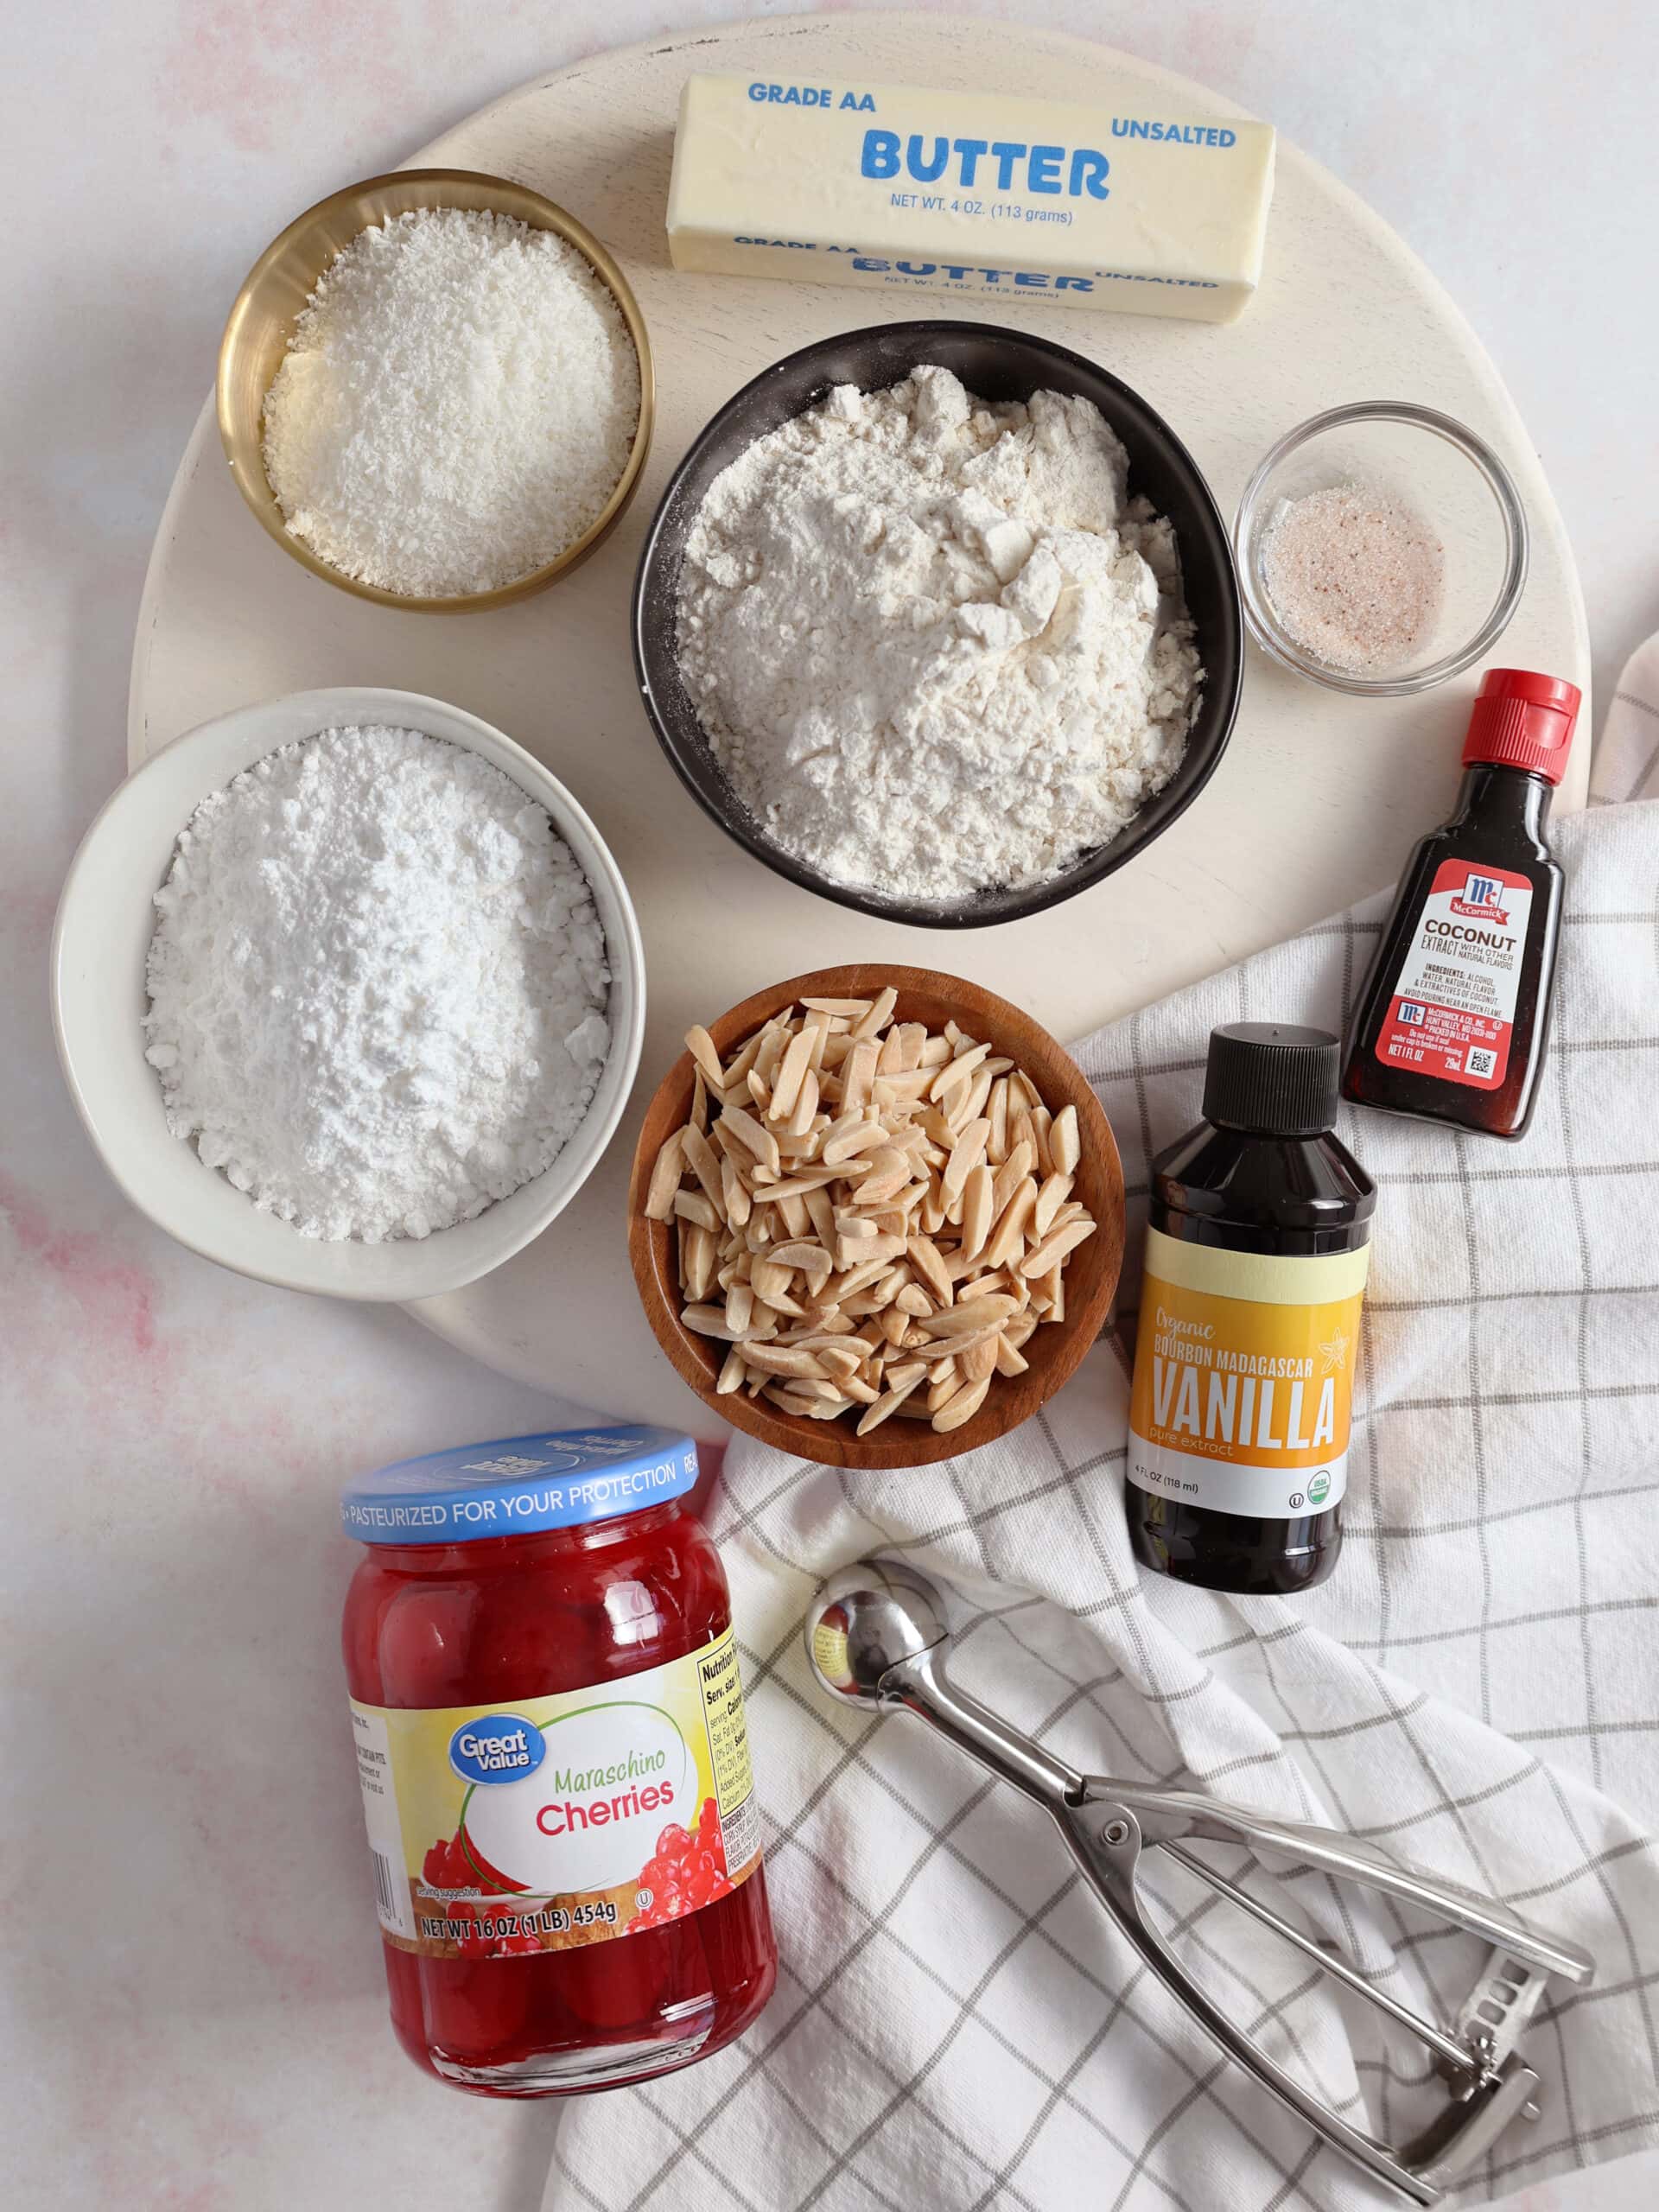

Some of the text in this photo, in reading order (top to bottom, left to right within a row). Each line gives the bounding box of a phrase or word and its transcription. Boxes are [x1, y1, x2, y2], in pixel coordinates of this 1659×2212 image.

[748, 82, 876, 112] GRADE AA
[1111, 118, 1236, 148] UNSALTED
[860, 129, 1110, 200] BUTTER
[891, 194, 1072, 226] NET WT. 4 OZ. (113 grams)
[734, 236, 861, 254] GRADE AA
[852, 257, 1095, 292] BUTTER
[1095, 270, 1219, 289] UNSALTED
[1452, 903, 1503, 918] McCormick
[1421, 935, 1514, 962] EXTRACT WITH OTHER
[1425, 919, 1516, 951] COCONUT
[1426, 963, 1466, 978] INGREDIENTS:
[1459, 951, 1514, 970] NATURAL FLAVORS
[1404, 988, 1421, 998] AVOID
[1420, 980, 1460, 995] EXTRACTIVES
[1446, 977, 1472, 990] NATURAL
[1389, 1043, 1402, 1057] NET
[1406, 1046, 1414, 1059] FL
[1414, 1049, 1424, 1062] OZ
[1156, 1306, 1216, 1339] Organic
[1154, 1333, 1313, 1378] BOURBON MADAGASCAR
[1154, 1356, 1334, 1450] VANILLA
[1149, 1427, 1234, 1457] pure extract
[350, 1504, 447, 1526] PASTEURIZED
[452, 1500, 498, 1523] FOR
[500, 1490, 563, 1519] YOUR
[569, 1461, 677, 1507] PROTECTION
[1150, 1471, 1162, 1484] OZ
[1164, 1476, 1181, 1489] (118
[1183, 1482, 1198, 1494] ml)
[702, 1651, 733, 1682] Nutrition
[706, 1687, 725, 1705] Serv.
[459, 1728, 528, 1758] Great
[477, 1751, 530, 1770] Value
[555, 1750, 665, 1794] Maraschino
[537, 1780, 674, 1835] Cherries
[441, 1886, 480, 1900] suggestion
[422, 1918, 445, 1937] NET
[447, 1919, 470, 1937] WT
[474, 1918, 493, 1937] 16
[496, 1916, 518, 1936] OZ
[521, 1914, 537, 1936] (1
[542, 1908, 569, 1930] LB)
[573, 1902, 616, 1923] 454g
